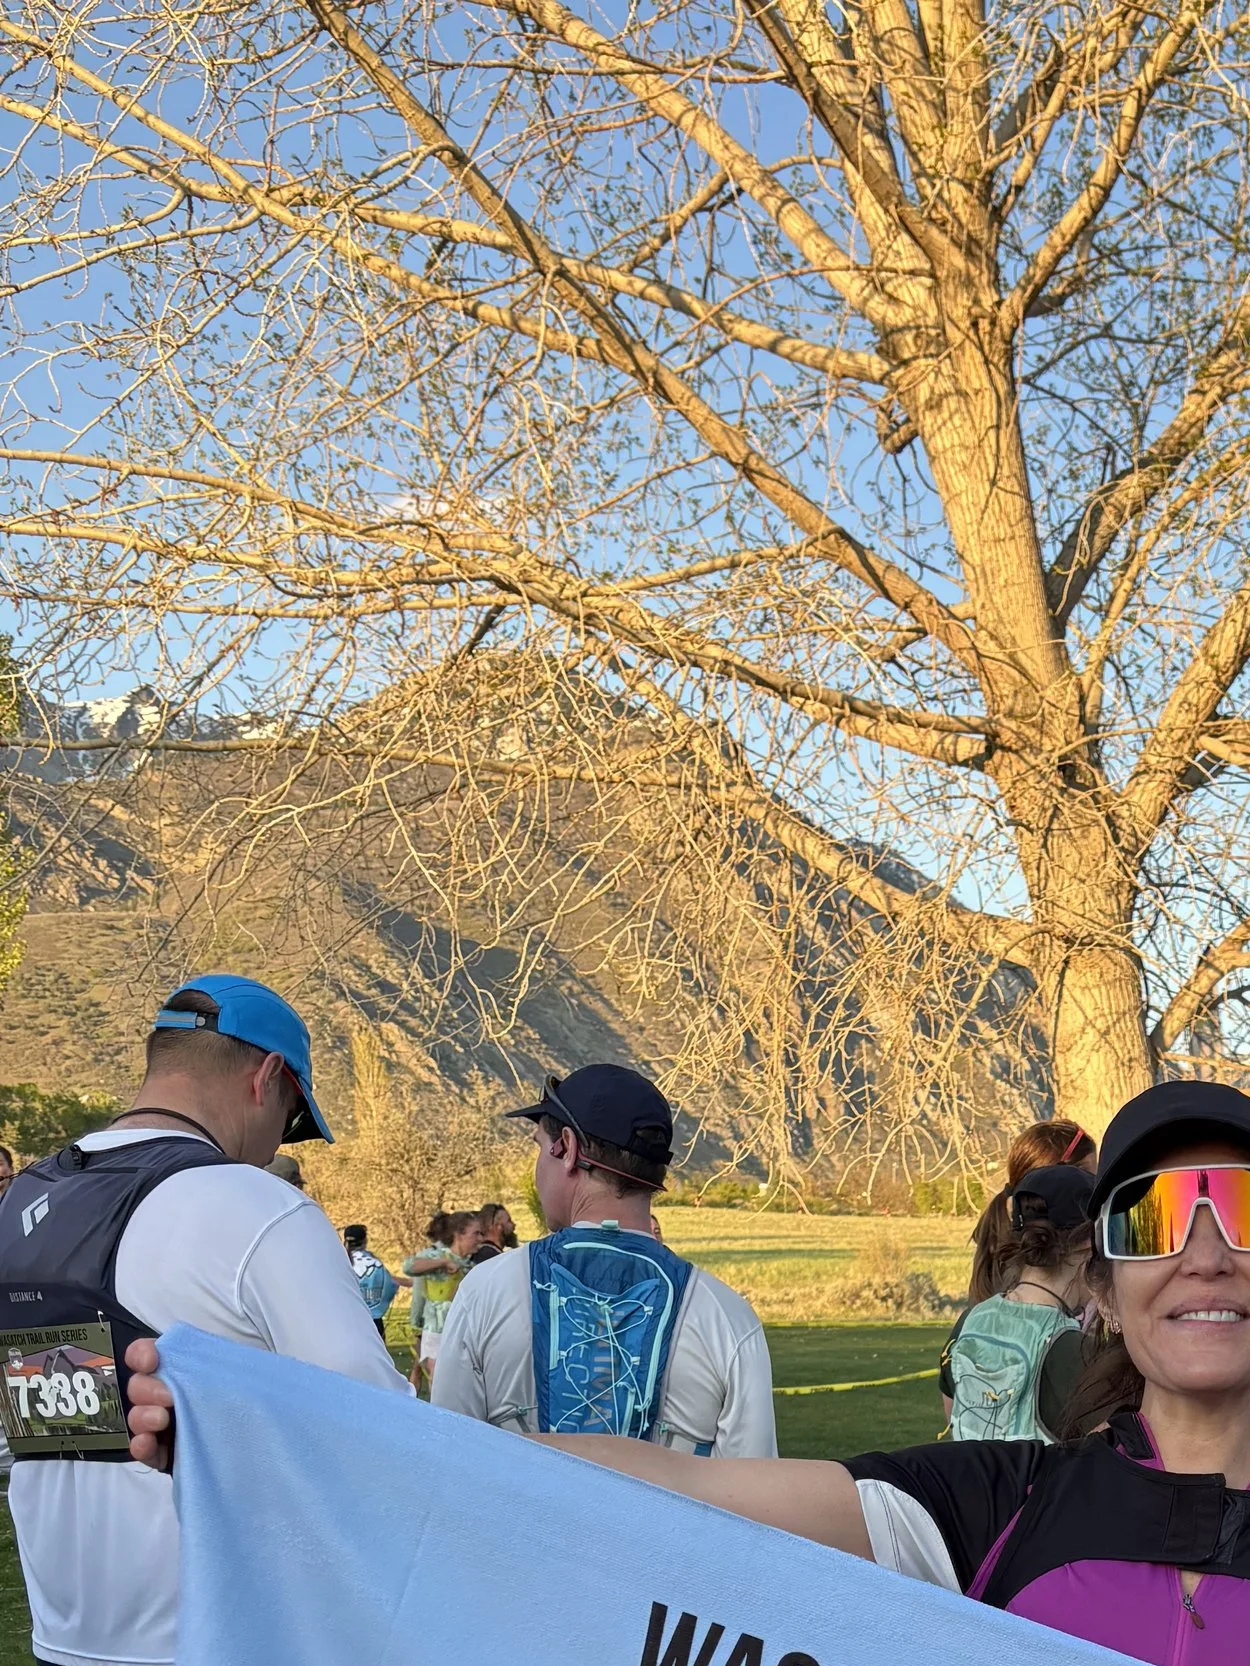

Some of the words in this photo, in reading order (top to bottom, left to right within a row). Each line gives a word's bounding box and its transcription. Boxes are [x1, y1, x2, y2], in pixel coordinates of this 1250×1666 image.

[9, 1291, 35, 1302] DISTANCE
[37, 1290, 43, 1301] 4
[26, 1331, 46, 1345] TRAIL
[45, 1330, 61, 1344] RUN
[62, 1328, 88, 1342] SERIES
[8, 1371, 100, 1418] 7338
